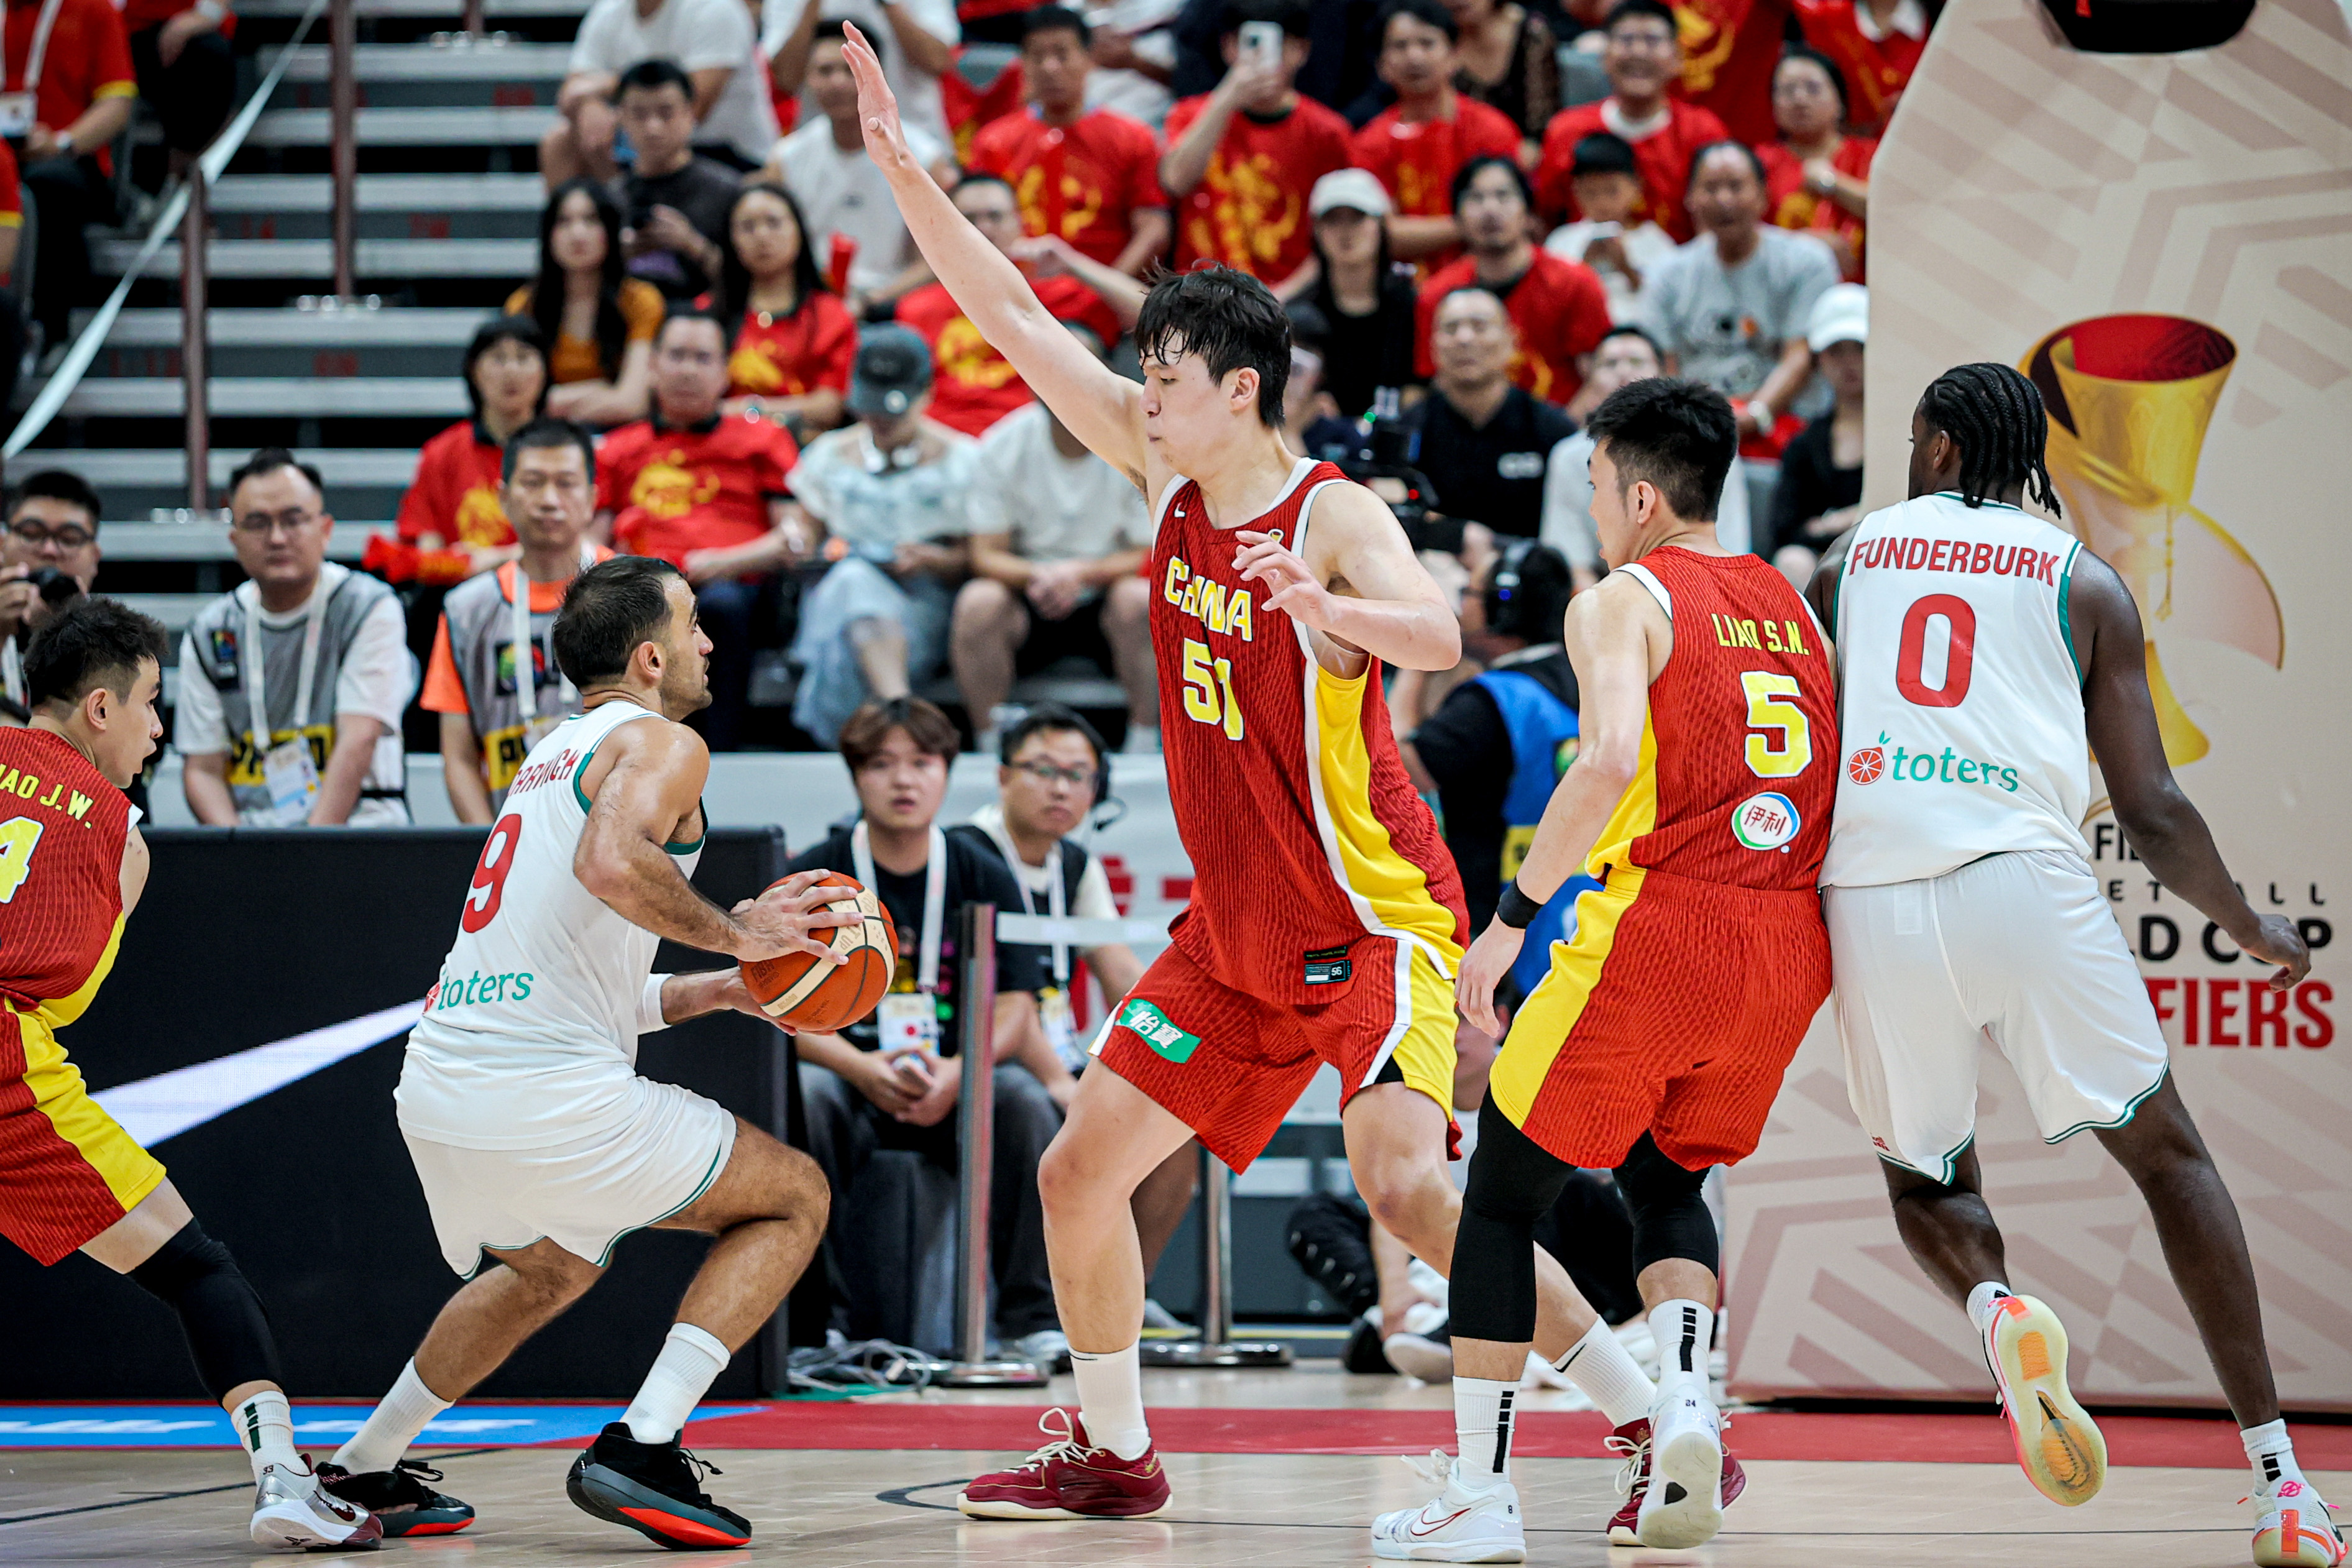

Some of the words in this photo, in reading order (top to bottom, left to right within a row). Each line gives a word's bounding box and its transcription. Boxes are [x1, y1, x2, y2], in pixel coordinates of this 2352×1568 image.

[1849, 536, 2059, 587] FUNDERBURK
[1711, 613, 1762, 651] LIAO
[1763, 620, 1810, 656] S.N.
[1896, 594, 1977, 708] 0
[1183, 637, 1244, 741] 51
[1740, 671, 1812, 778] 5
[1892, 747, 2019, 792] toters
[39, 784, 93, 829] J.W.
[1745, 804, 1787, 837] 伊利
[462, 813, 522, 933] 9
[2202, 917, 2332, 965] CP
[437, 971, 533, 1011] toters
[1331, 966, 1343, 976] 56
[1129, 1011, 1183, 1049] 怡寶
[1508, 1505, 1513, 1514] 8
